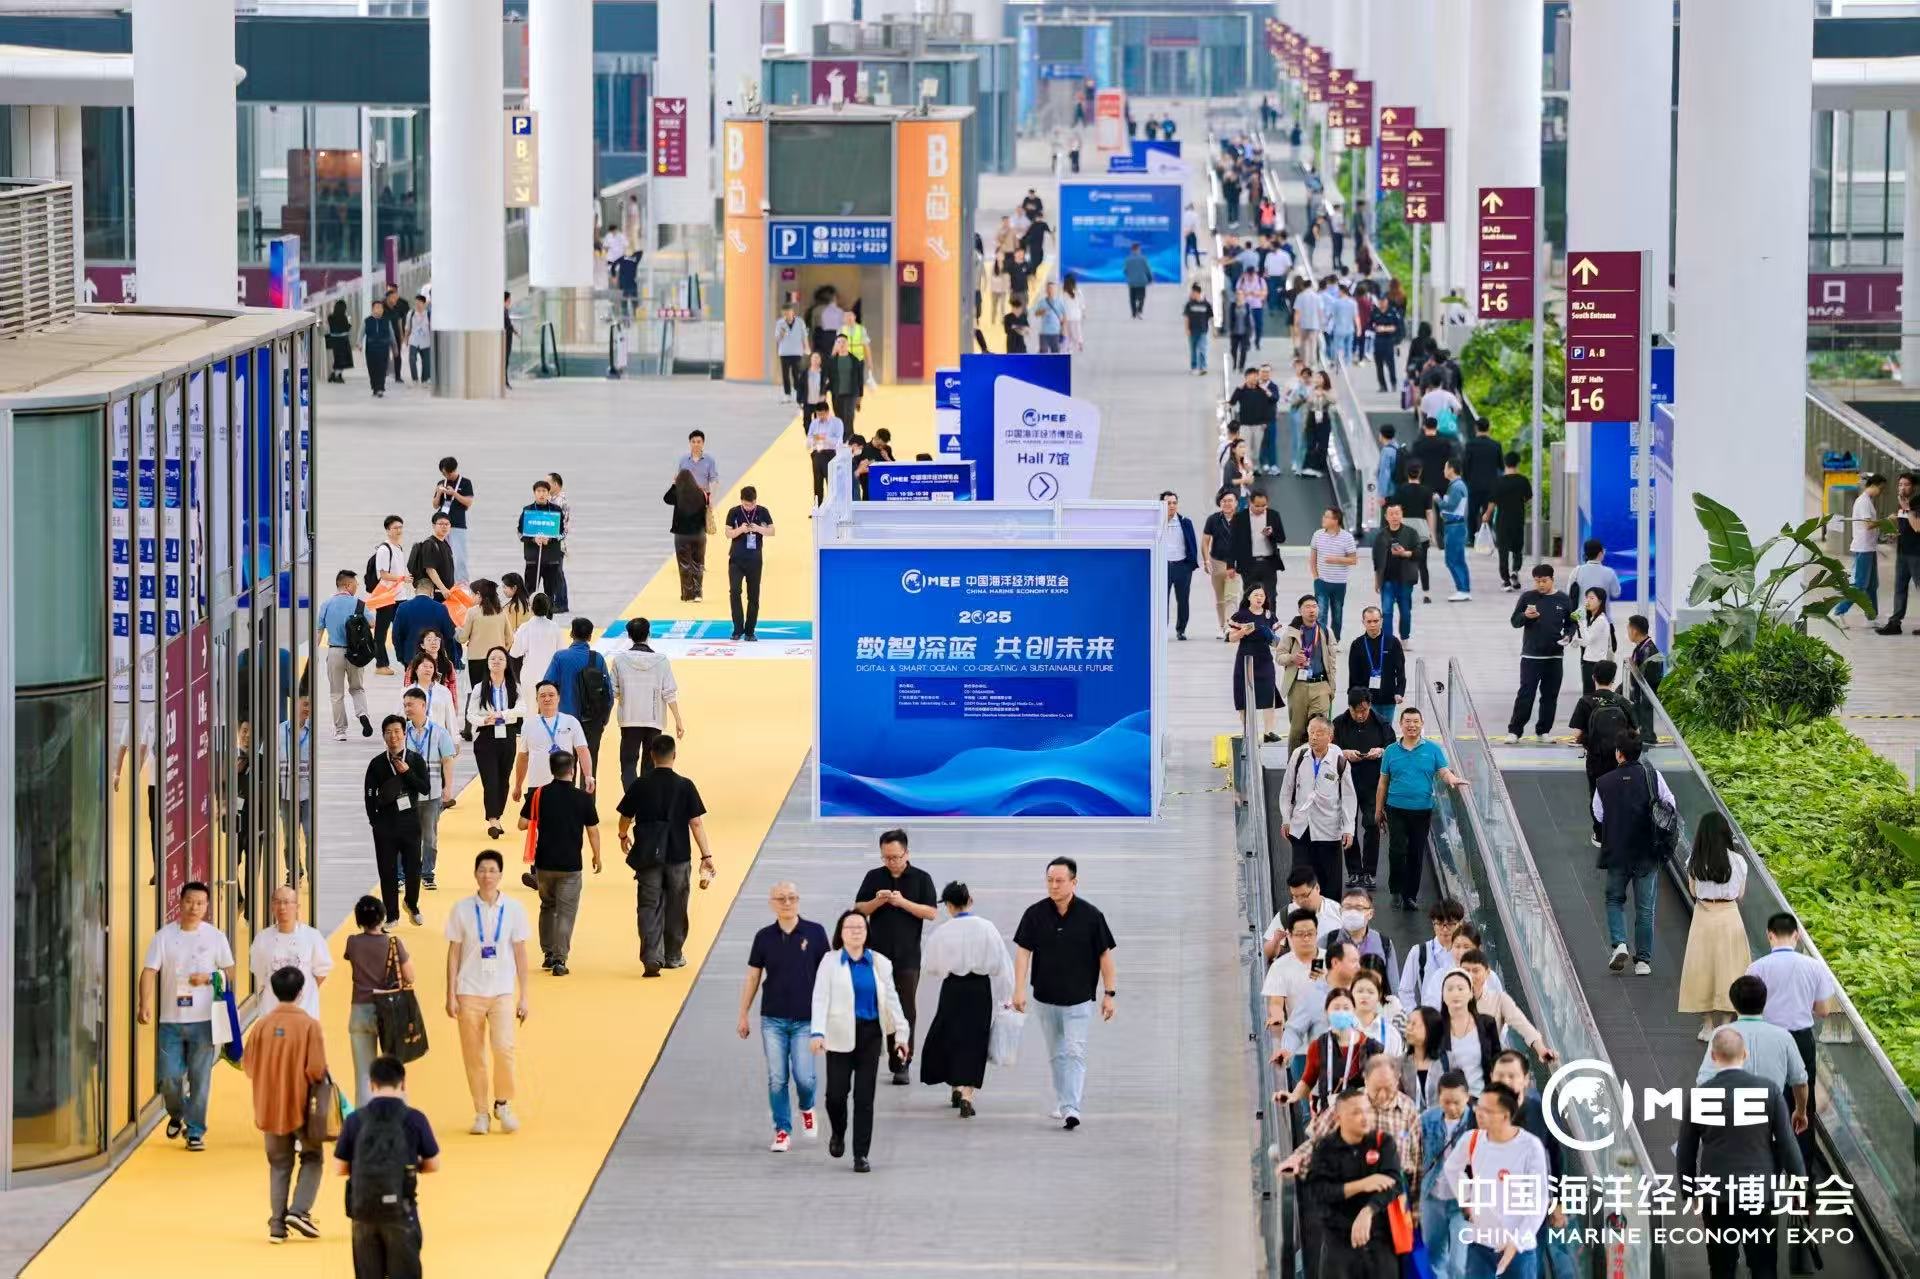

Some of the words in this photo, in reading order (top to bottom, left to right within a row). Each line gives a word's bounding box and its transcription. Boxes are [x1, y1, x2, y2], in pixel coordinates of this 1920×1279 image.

[515, 118, 528, 134] P
[928, 134, 948, 178] B
[1407, 204, 1426, 218] 1-6
[782, 228, 798, 256] P
[1481, 292, 1508, 312] 1-6
[1570, 388, 1605, 411] 1-6
[1018, 452, 1044, 464] Hall
[966, 575, 1068, 587] 中国海洋经济博览会
[856, 636, 977, 660] 数智深蓝
[994, 636, 1114, 660] 共创未来
